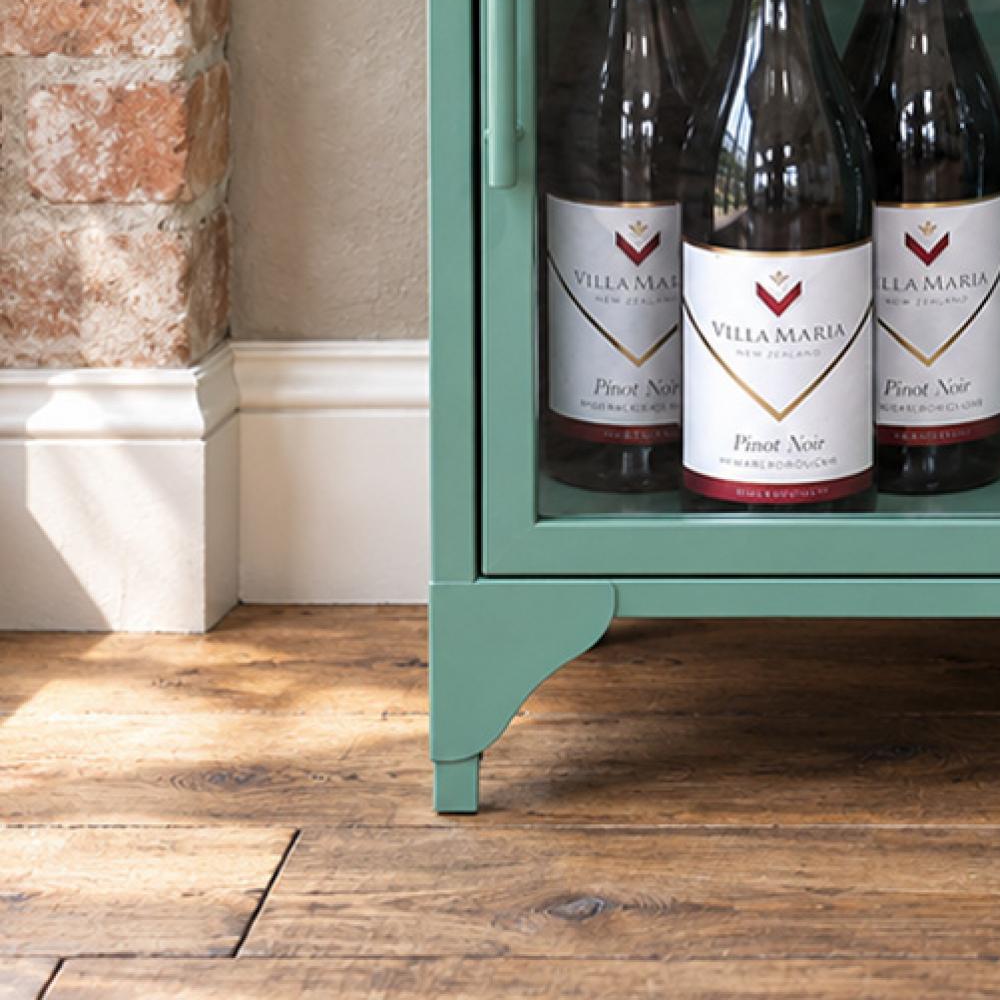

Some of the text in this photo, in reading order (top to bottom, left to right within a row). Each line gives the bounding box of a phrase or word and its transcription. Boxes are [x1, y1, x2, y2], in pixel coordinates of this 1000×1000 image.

[573, 269, 629, 290] VILLA
[881, 271, 988, 291] LLA MARIA
[711, 320, 846, 343] VILLA MARIA
[594, 378, 639, 396] Pinot
[884, 377, 971, 397] Pinot Noir
[733, 434, 825, 453] Pinot Noir
